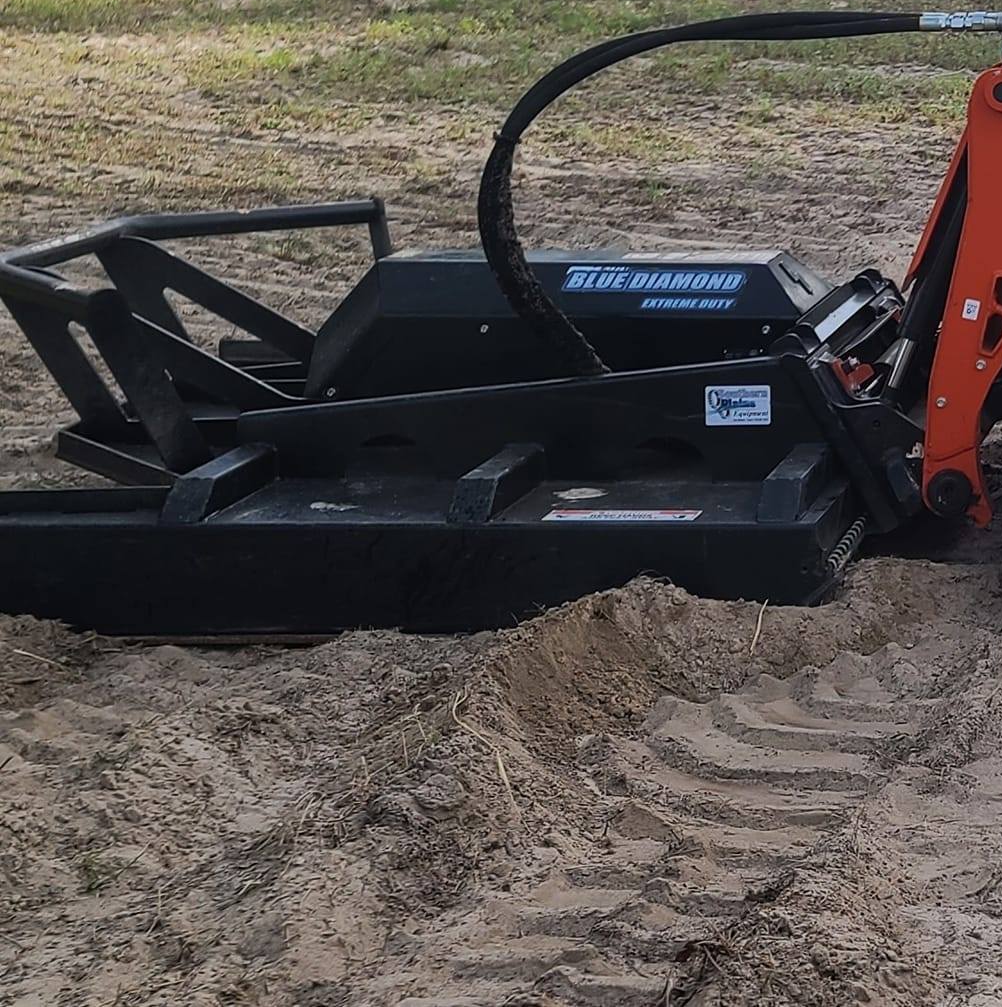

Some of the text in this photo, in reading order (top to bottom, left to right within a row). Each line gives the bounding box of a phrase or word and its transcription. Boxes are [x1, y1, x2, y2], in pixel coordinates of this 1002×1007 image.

[565, 272, 743, 290] BLUE DIAMOND
[641, 298, 735, 309] EXTREME DUTY
